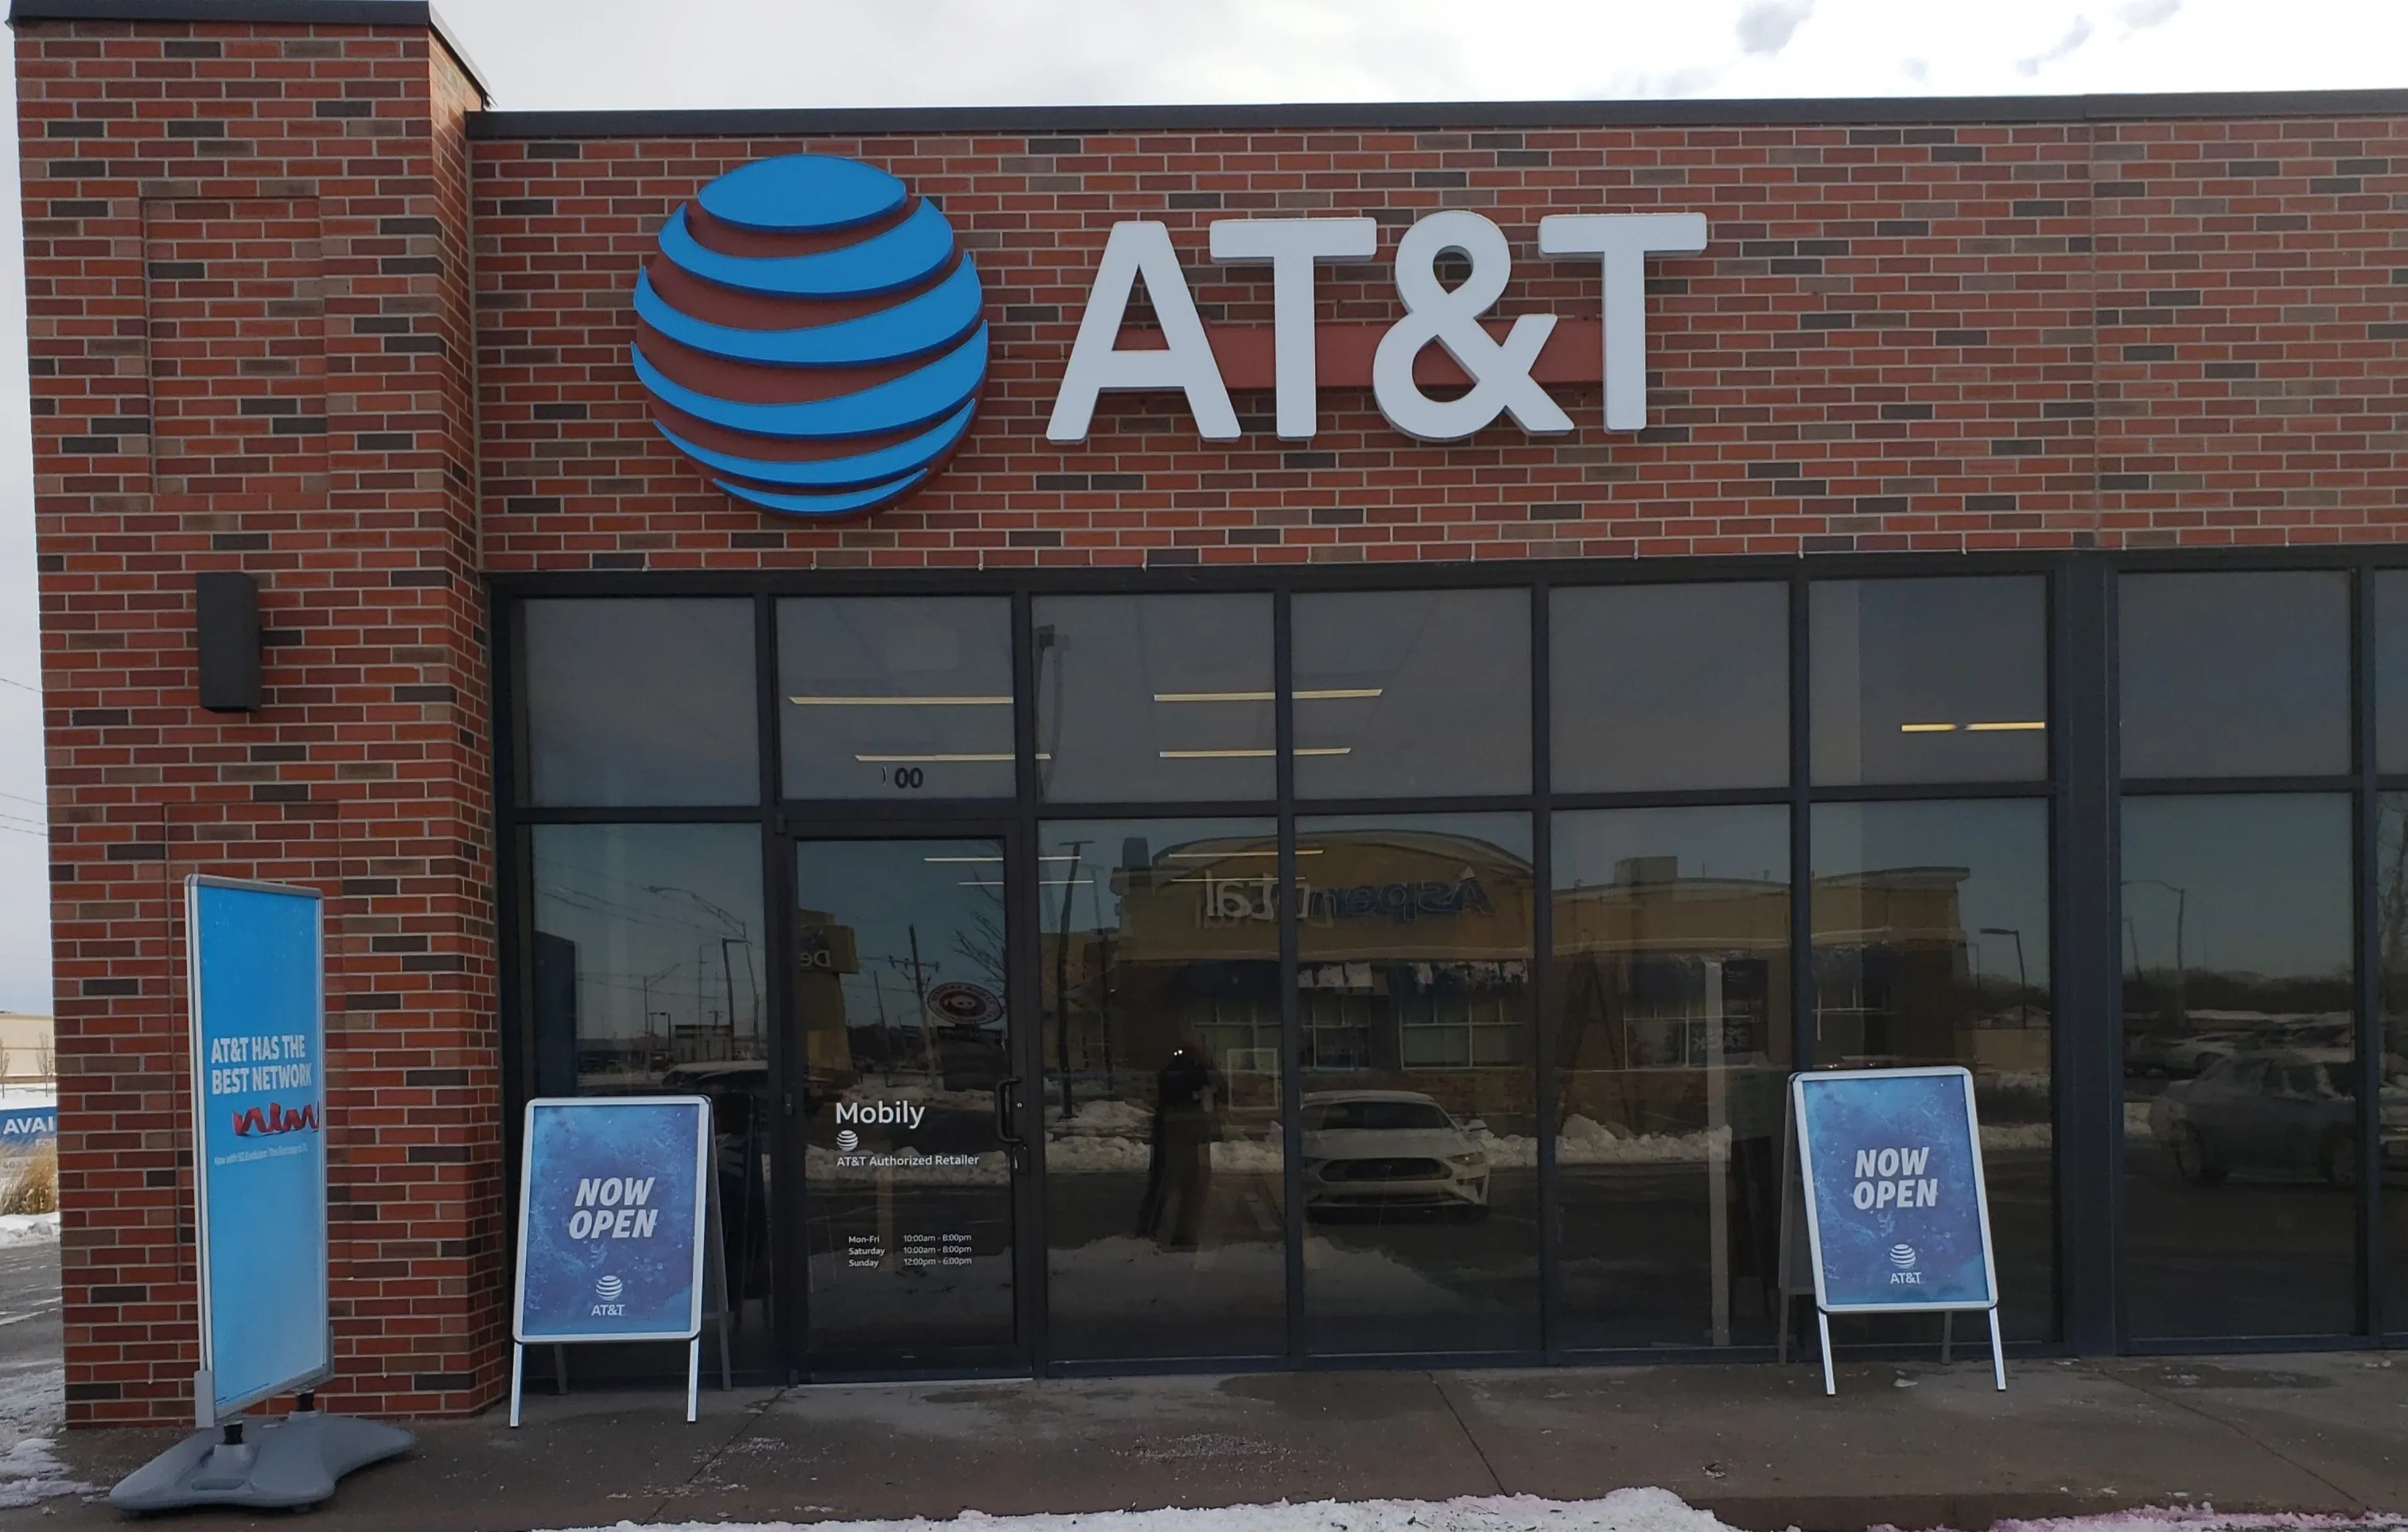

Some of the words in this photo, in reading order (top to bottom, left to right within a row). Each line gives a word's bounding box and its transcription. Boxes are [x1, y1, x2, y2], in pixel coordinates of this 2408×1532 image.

[1046, 210, 1707, 444] AT&T
[211, 1036, 248, 1063] AT&T
[251, 1036, 279, 1061] HAS
[282, 1034, 305, 1059] THE
[212, 1067, 249, 1095] BEST
[251, 1063, 312, 1091] NETWORK
[835, 1100, 925, 1129] Mobily
[837, 1156, 866, 1167] AT&T
[869, 1155, 933, 1167] Authorized
[935, 1155, 980, 1166] Retailer
[1854, 1146, 1930, 1178] NOW
[574, 1176, 655, 1207] NOW
[1853, 1178, 1939, 1210] OPEN
[569, 1209, 659, 1239] OPEN
[848, 1247, 885, 1256] Saturday
[849, 1258, 880, 1268] Sunday
[904, 1258, 936, 1266] 12:00pm
[943, 1258, 972, 1266] 6:00pm
[1889, 1272, 1922, 1284] AT&T
[591, 1305, 625, 1316] AT&T
